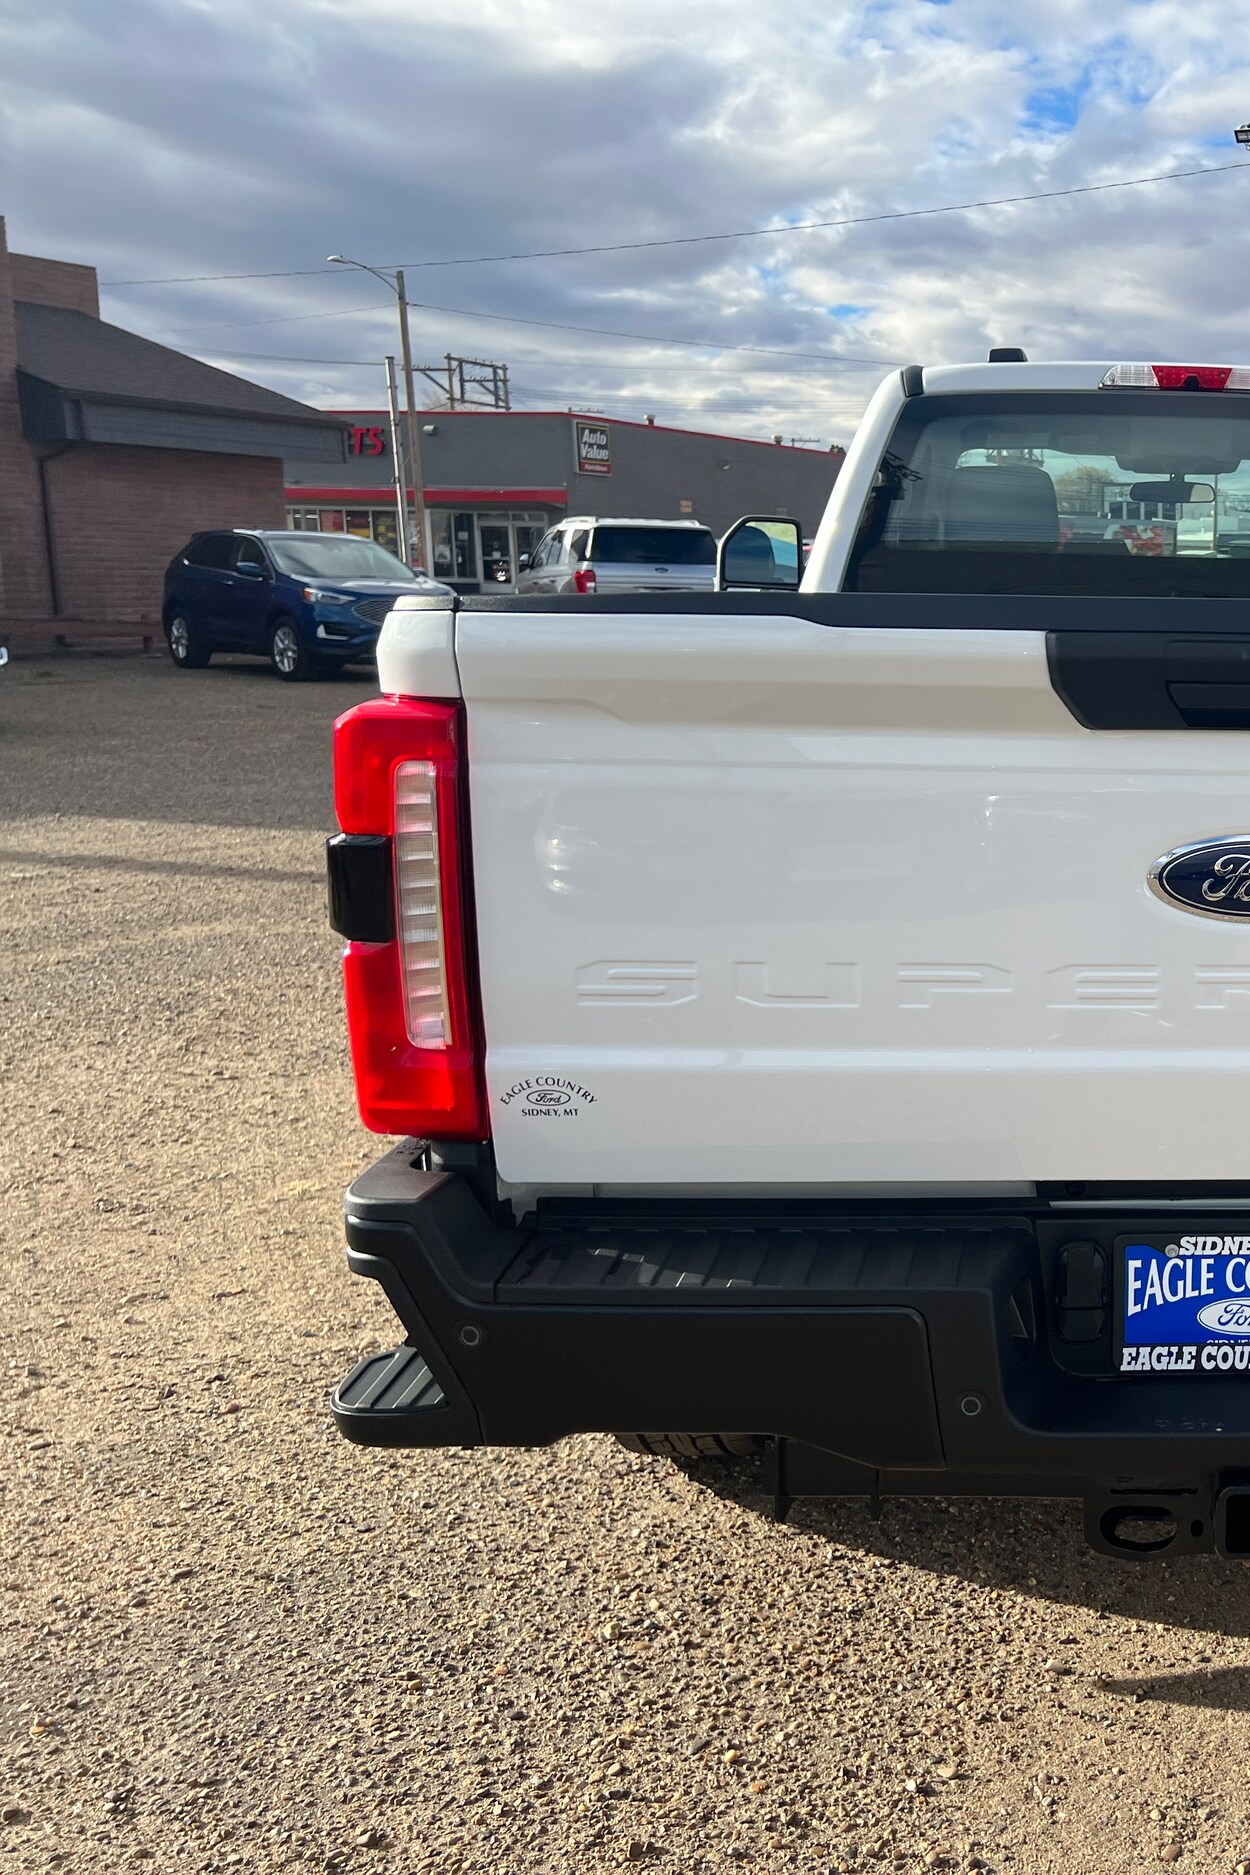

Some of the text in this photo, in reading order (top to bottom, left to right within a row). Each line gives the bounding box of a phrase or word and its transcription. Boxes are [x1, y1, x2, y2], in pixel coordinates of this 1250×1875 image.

[581, 428, 607, 445] Auto
[580, 443, 609, 460] Value
[500, 1076, 598, 1105] EAGLE COUNTRY
[535, 1092, 562, 1104] Ford
[521, 1108, 579, 1117] SIDNEY, MT
[1127, 1258, 1214, 1317] EAGLE
[1119, 1346, 1198, 1371] EAGLE
